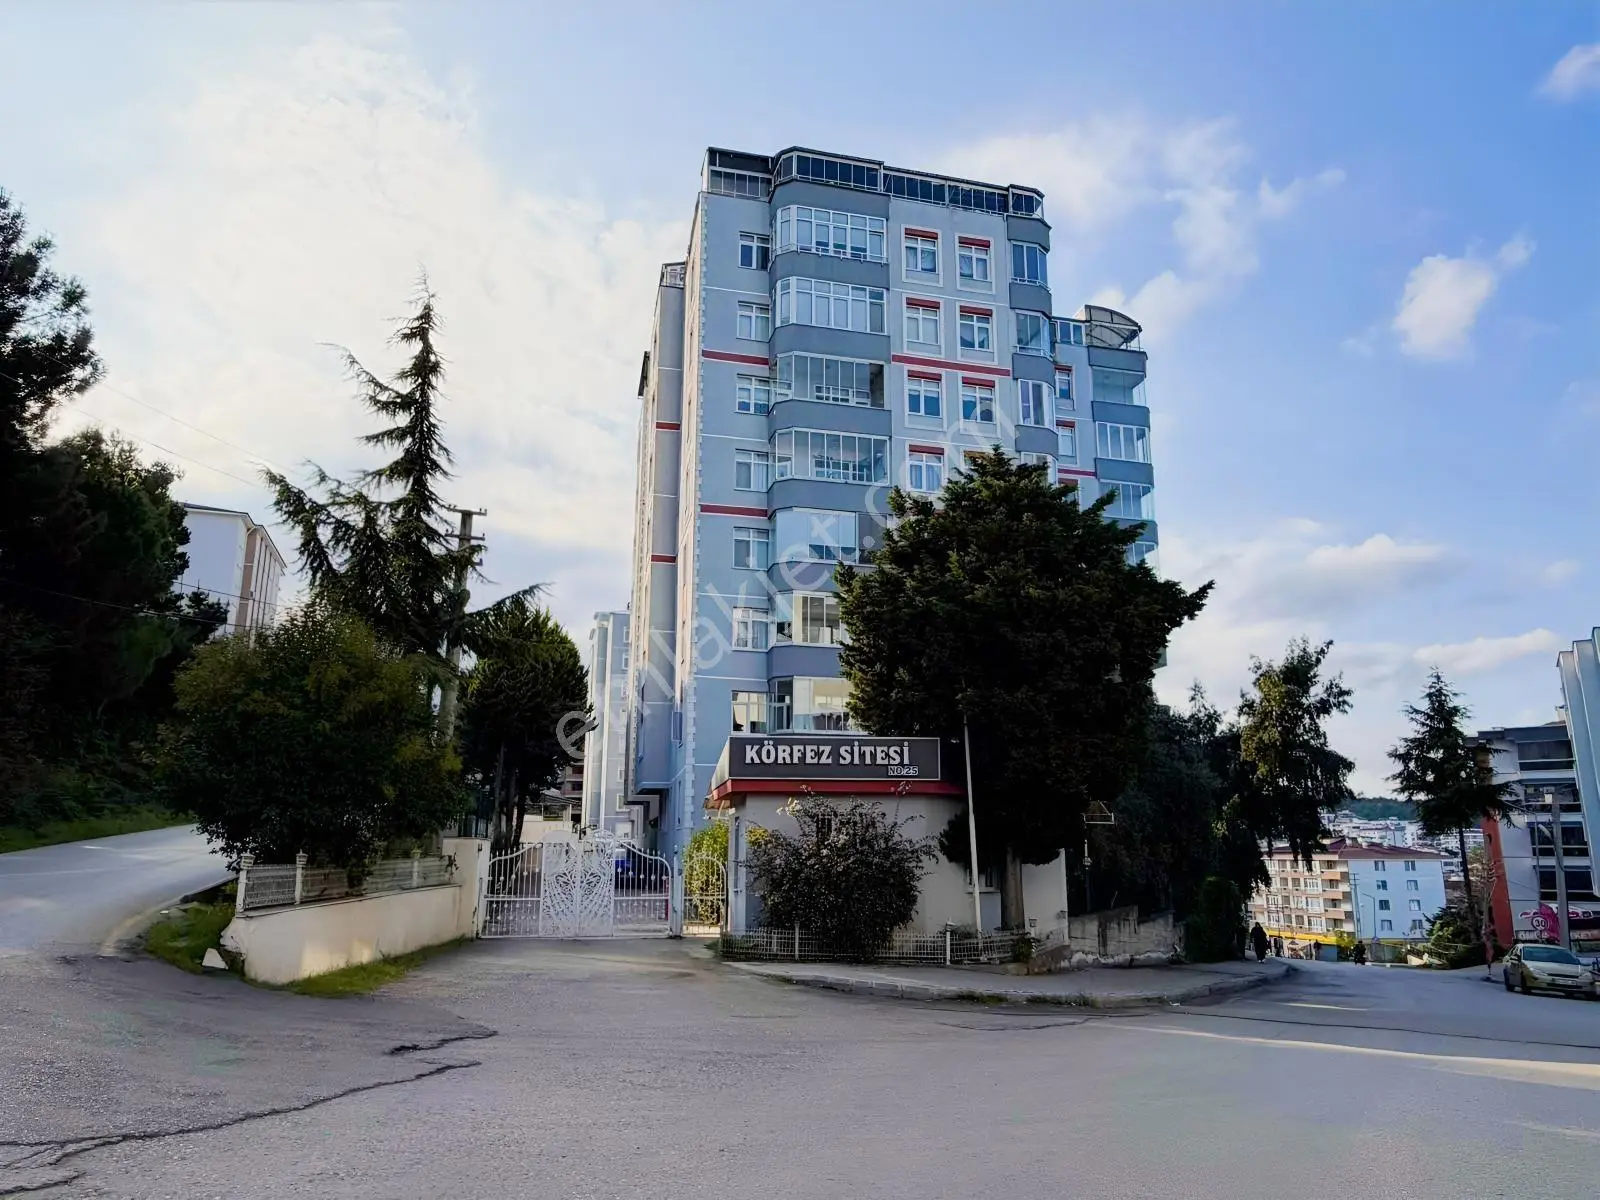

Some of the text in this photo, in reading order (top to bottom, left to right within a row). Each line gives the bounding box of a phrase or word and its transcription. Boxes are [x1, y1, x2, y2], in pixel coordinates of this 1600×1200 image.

[745, 740, 910, 765] KÖRFEZ SİTESİ
[1535, 919, 1546, 928] 30
